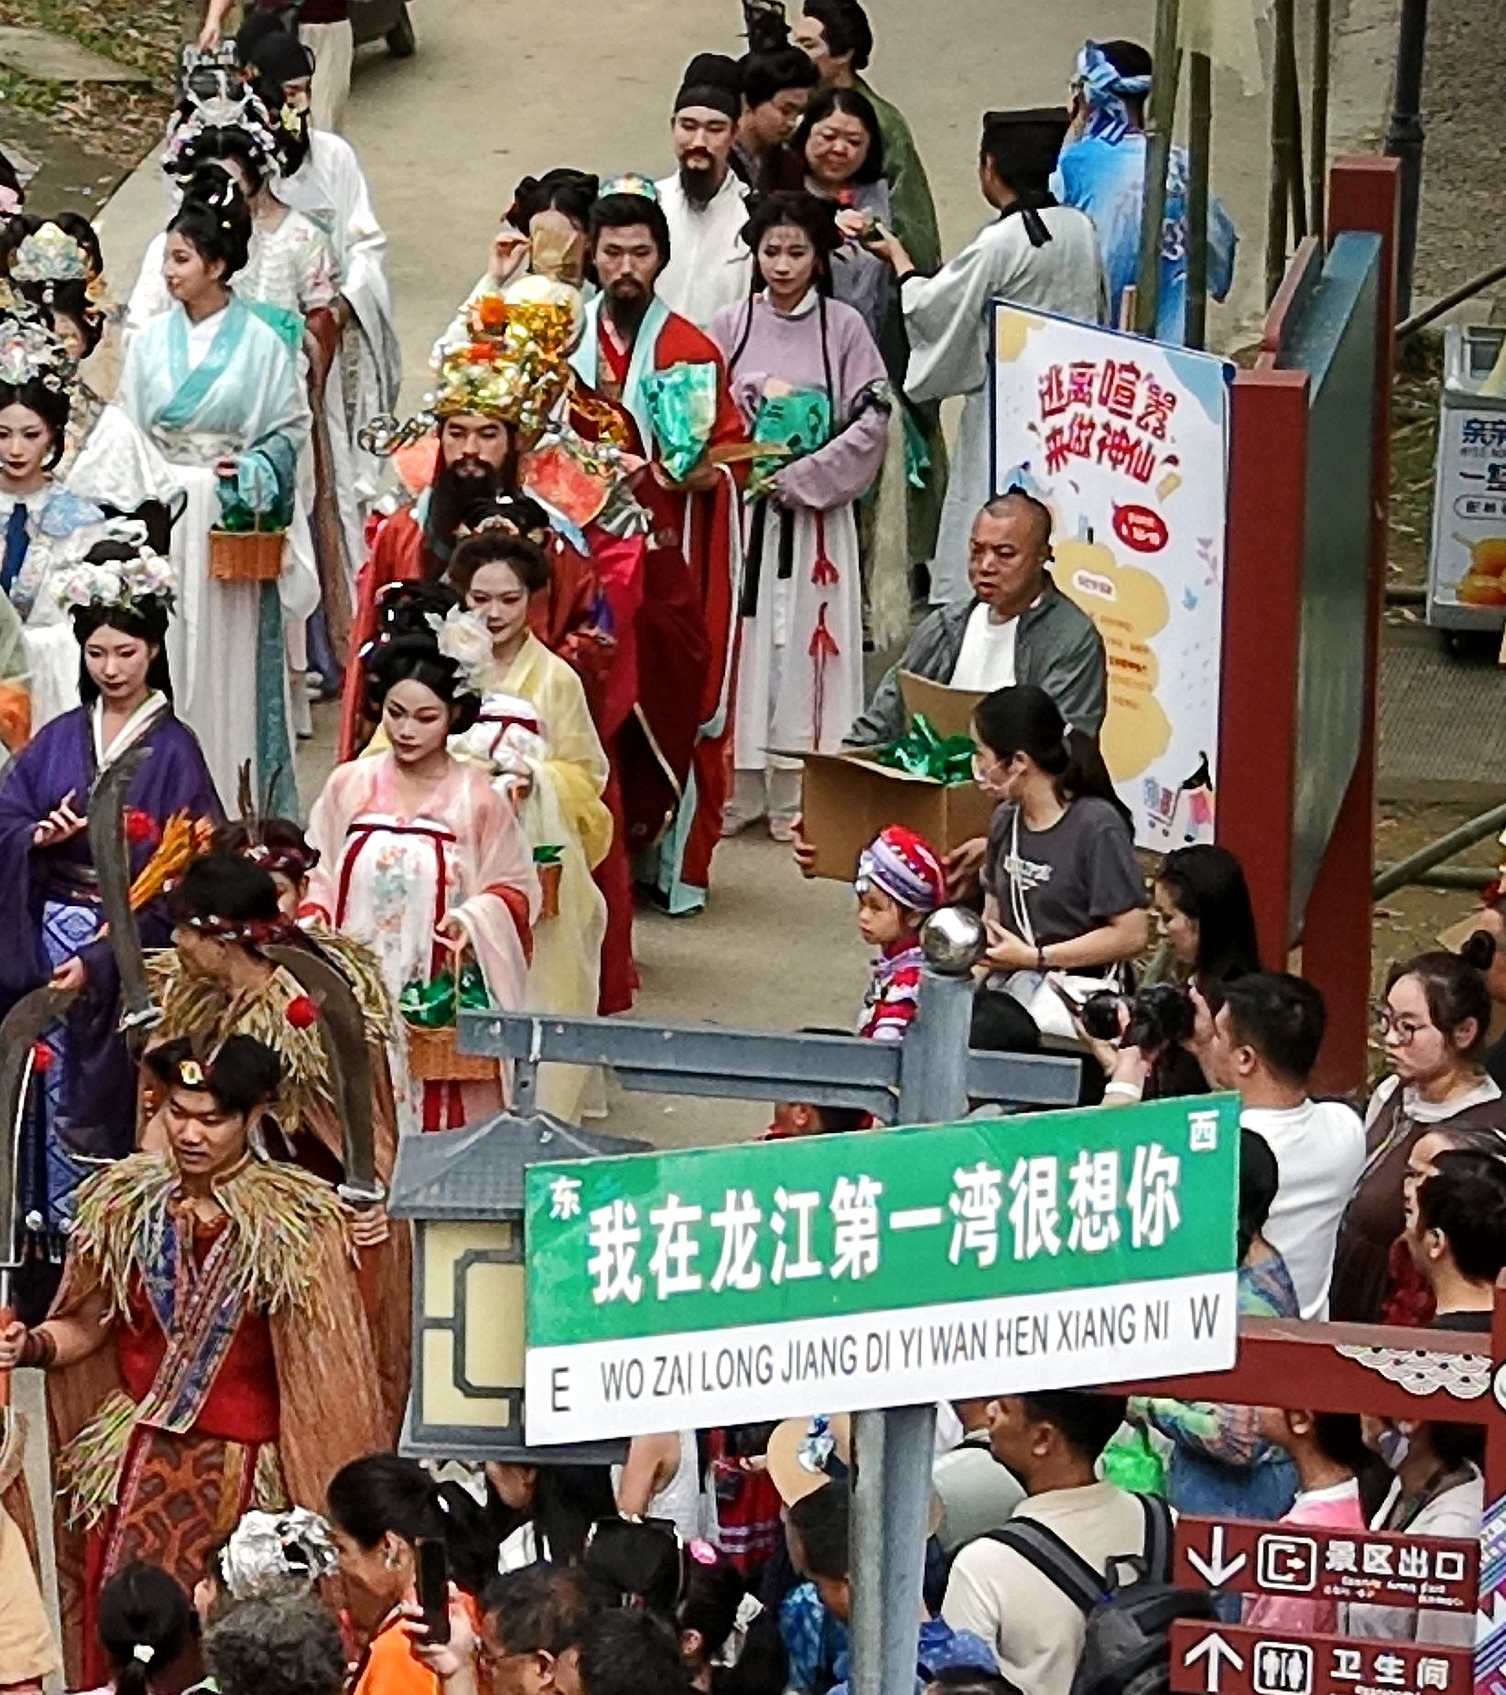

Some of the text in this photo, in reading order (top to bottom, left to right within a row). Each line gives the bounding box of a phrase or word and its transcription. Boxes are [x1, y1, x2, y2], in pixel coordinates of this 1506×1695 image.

[1187, 1109, 1220, 1152] 西
[549, 1176, 583, 1221] 东
[588, 1143, 1182, 1305] 我在龙江第一湾很想你
[551, 1293, 1220, 1413] E WO ZAI LONG JIANG DI YI WAN HEN XIANG NI W
[1325, 1540, 1464, 1581] 景区出口
[1330, 1648, 1450, 1691] 卫生间
